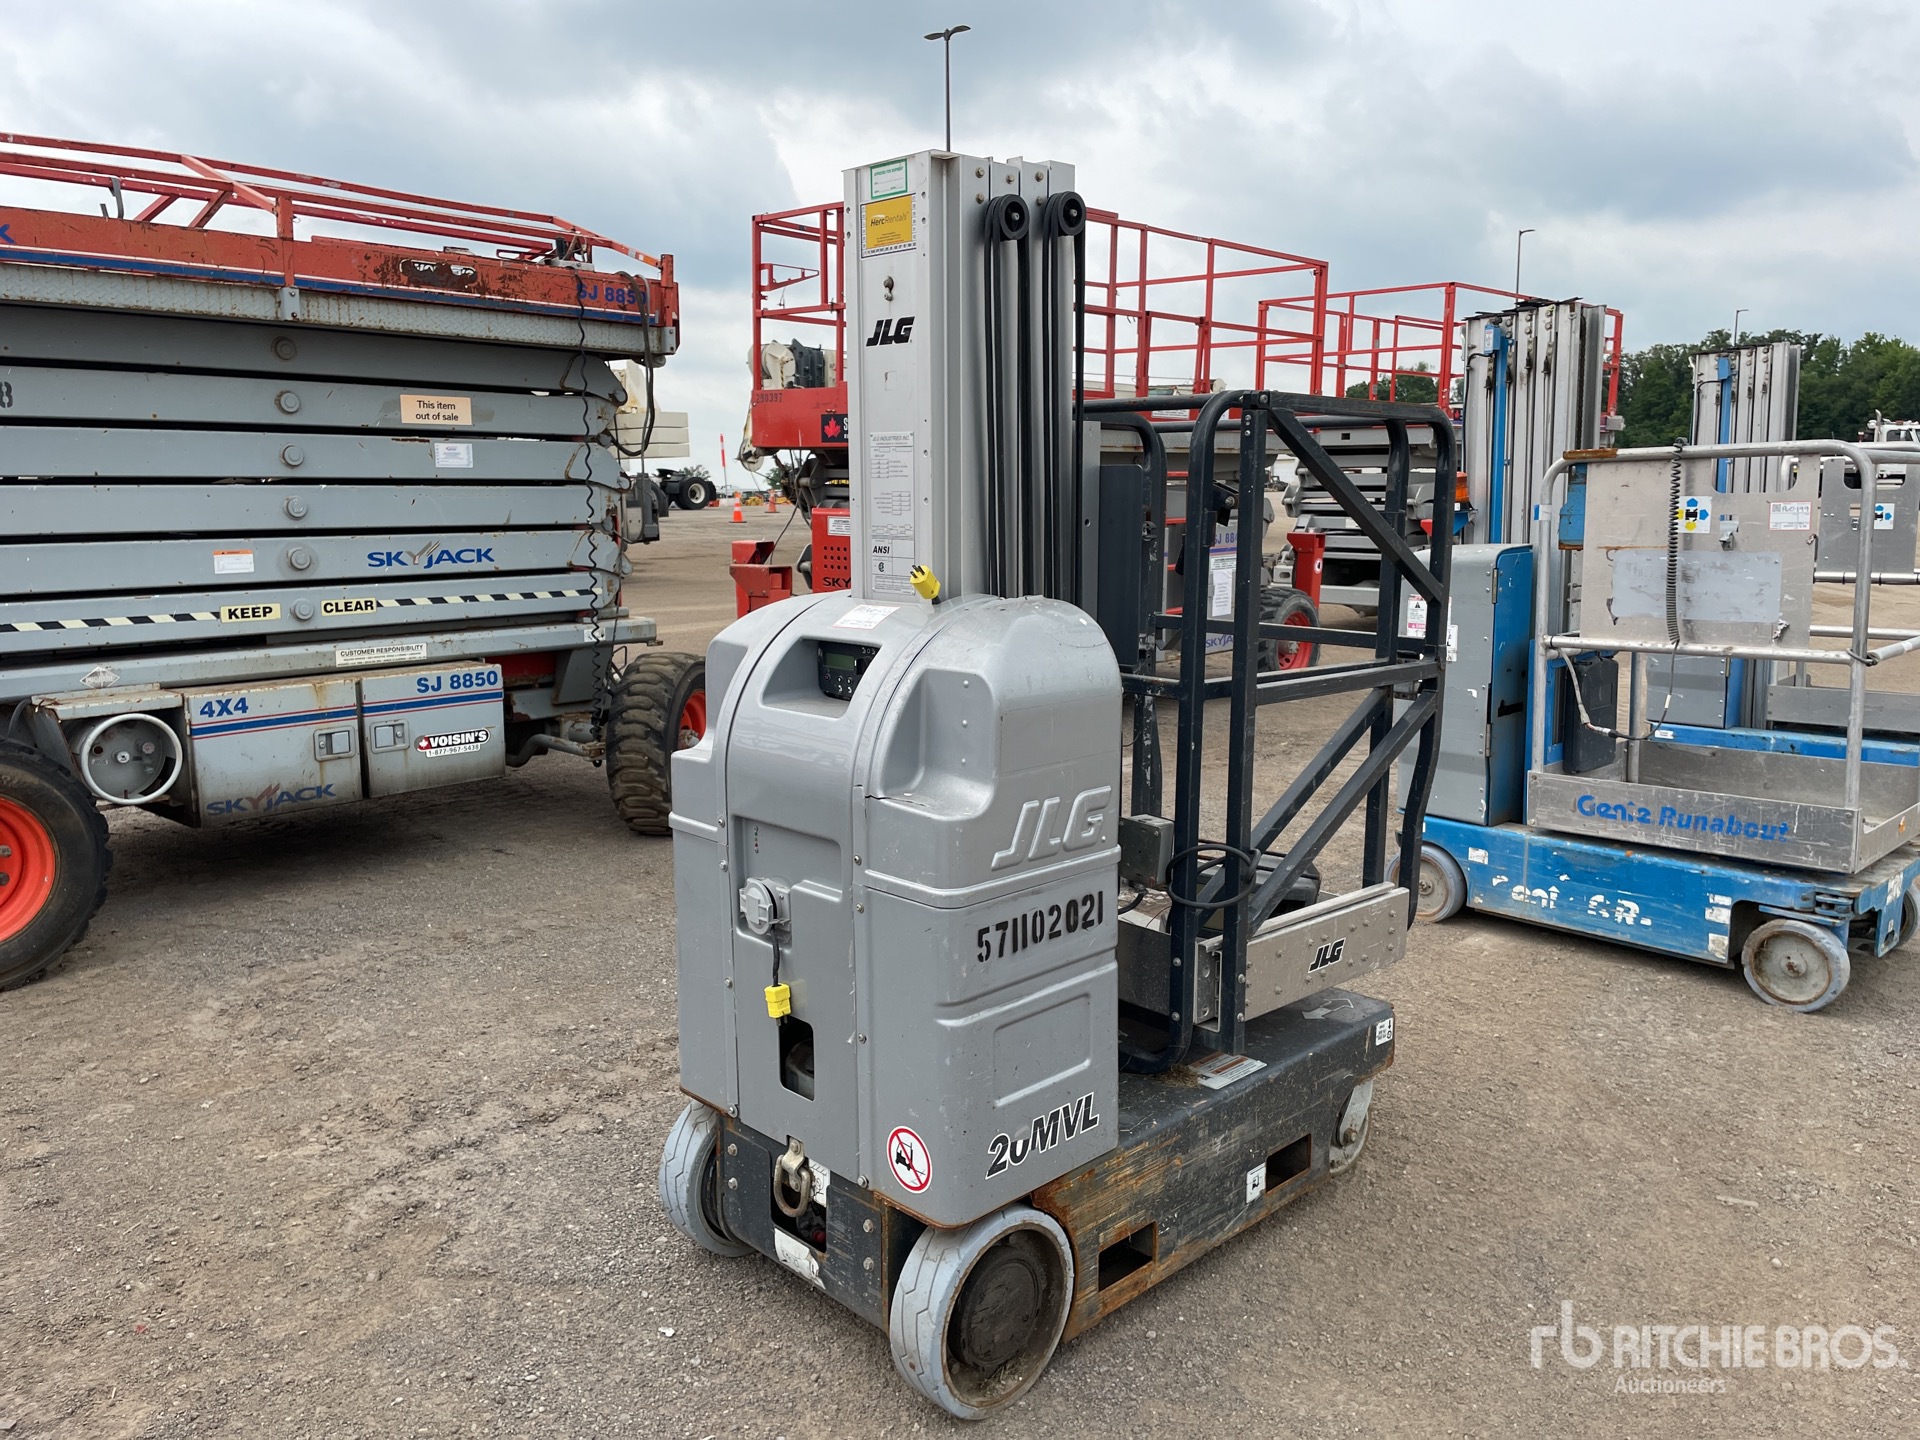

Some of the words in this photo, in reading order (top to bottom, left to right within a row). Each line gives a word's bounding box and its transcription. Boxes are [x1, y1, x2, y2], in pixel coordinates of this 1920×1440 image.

[866, 316, 914, 347] JLG
[416, 400, 435, 410] This
[436, 401, 456, 410] item
[432, 412, 440, 420] of
[442, 413, 458, 421] sale
[367, 540, 494, 570] SKYJACK
[873, 546, 890, 554] ANSI
[228, 606, 272, 620] KEEP
[324, 600, 374, 613] CLEAR
[340, 647, 375, 657] CUSTOMER
[376, 644, 424, 654] RESPONSIBILITY
[416, 676, 442, 694] SJ
[450, 670, 498, 690] 8850
[200, 696, 248, 718] 4X4
[430, 730, 487, 748] VOISIN'S
[206, 784, 336, 816] SKYJACK
[991, 785, 1112, 872] JLG
[1577, 794, 1654, 824] Genie
[1658, 806, 1790, 842] Runabout
[977, 890, 1104, 963] 571102021
[1308, 938, 1346, 974] JLG
